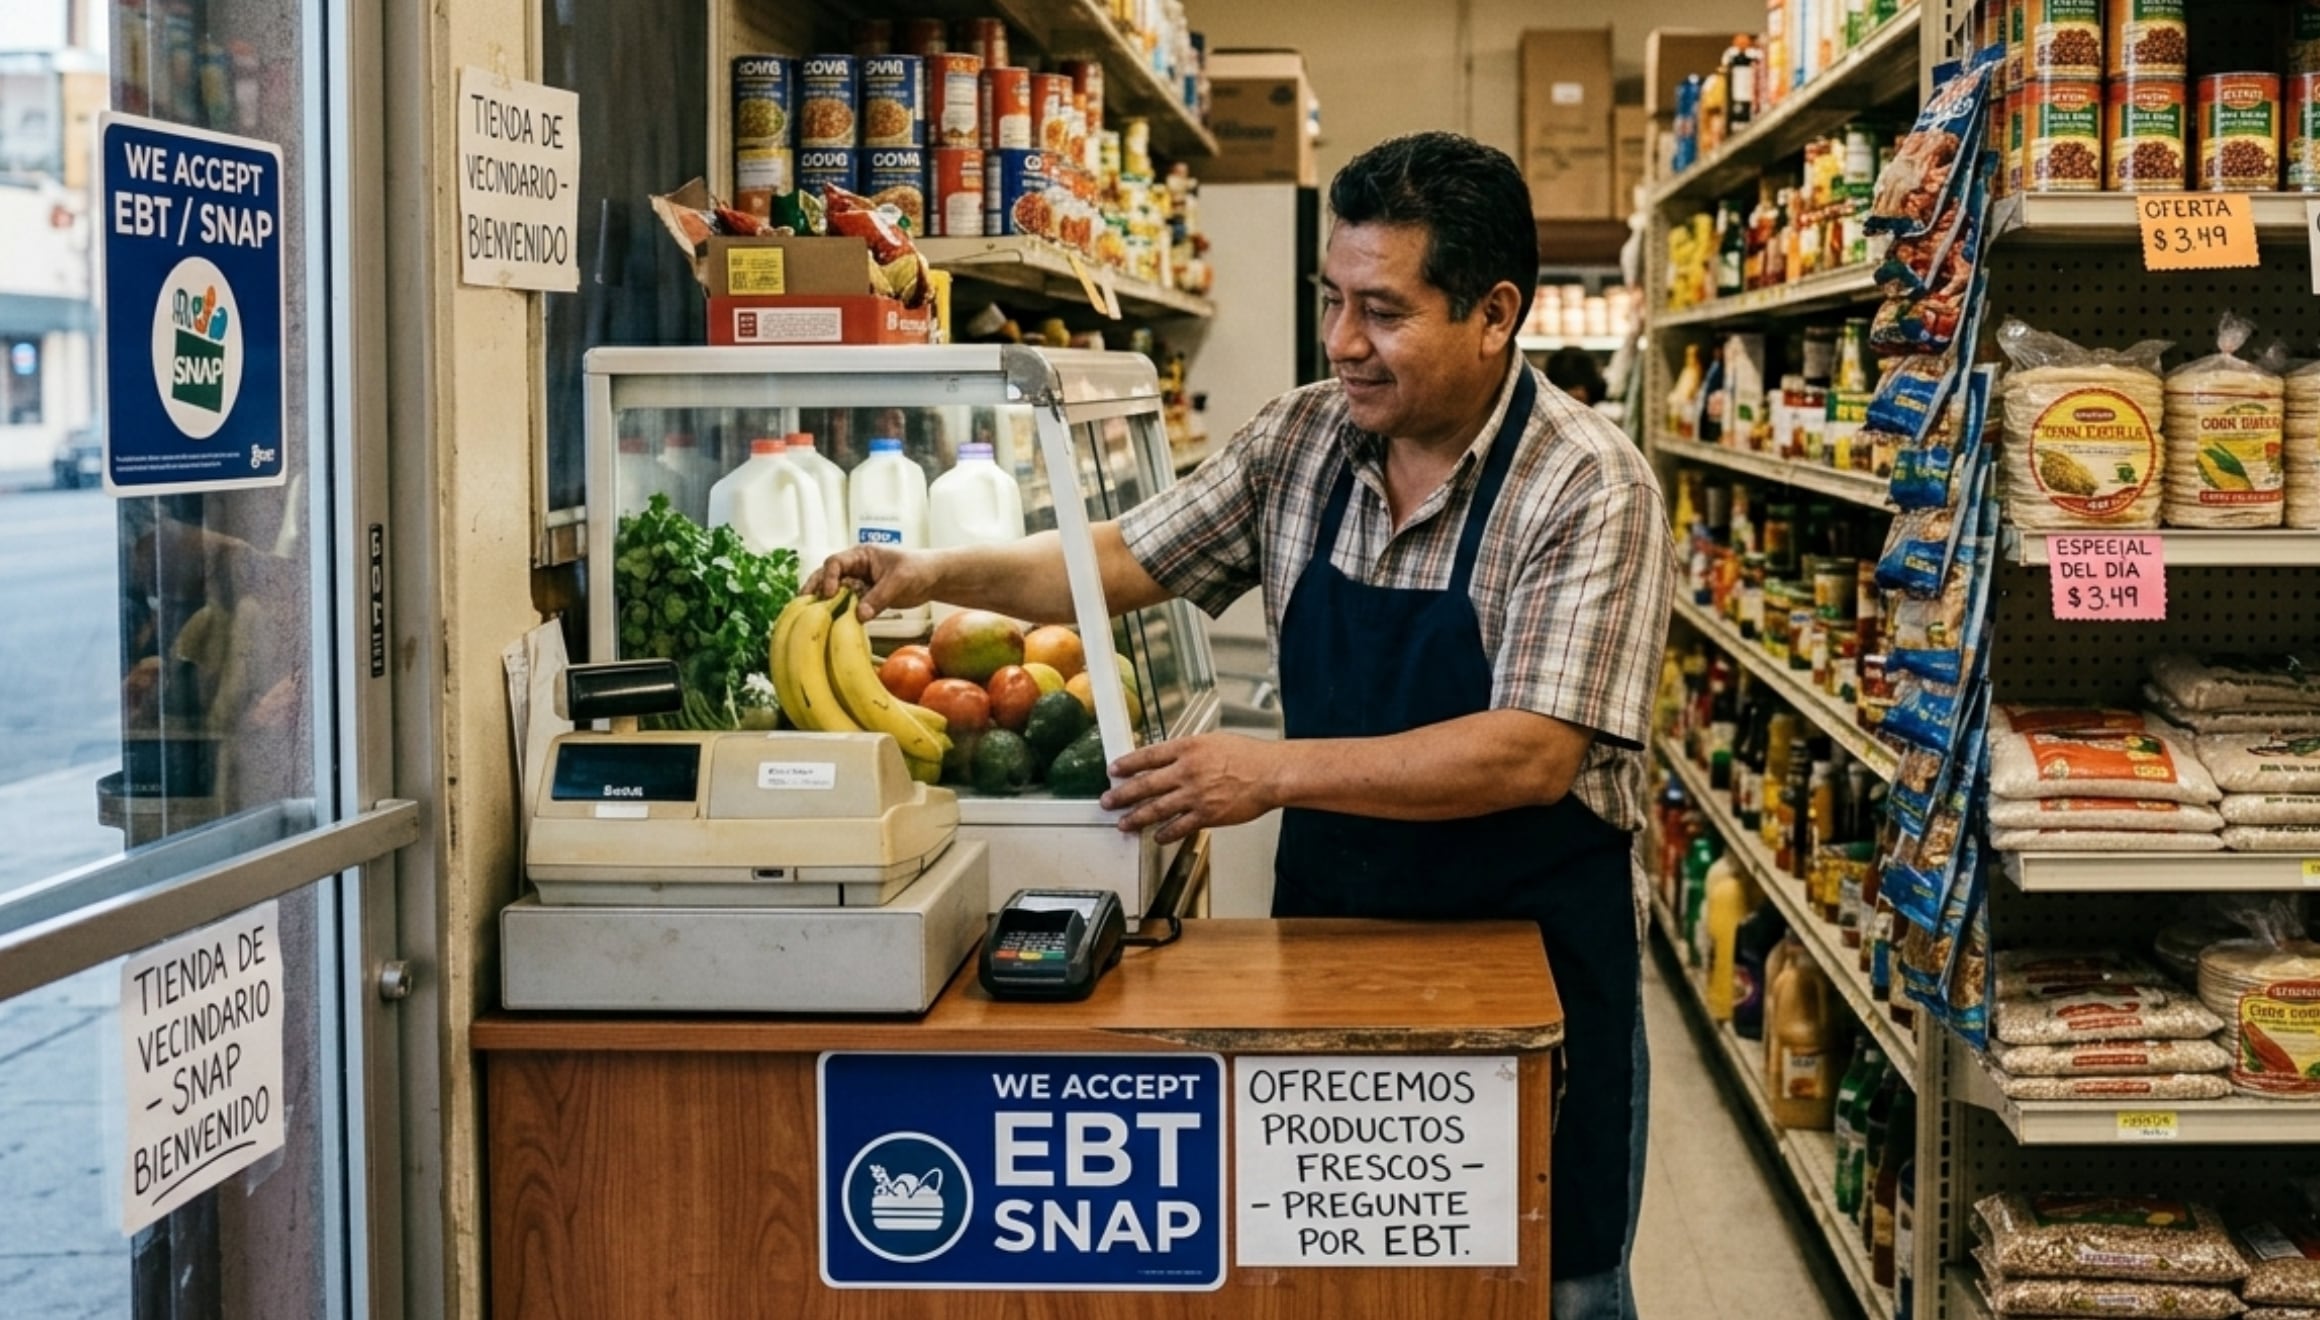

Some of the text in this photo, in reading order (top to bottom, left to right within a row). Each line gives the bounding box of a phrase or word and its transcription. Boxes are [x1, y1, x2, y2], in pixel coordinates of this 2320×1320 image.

[470, 94, 564, 149] TIENDA DE
[124, 142, 264, 196] WE ACCEPT
[466, 153, 558, 200] VECINDARIO
[115, 191, 172, 238] EBT
[200, 202, 273, 248] SNAP
[2145, 199, 2232, 218] OFERTA
[468, 214, 568, 265] BIENVENIDO
[174, 355, 224, 385] SNAP
[2060, 562, 2098, 579] DEL
[134, 925, 266, 1016] TIENDA DE
[137, 979, 270, 1073] VECINDARIO
[172, 1043, 242, 1115] SNAP
[993, 1073, 1200, 1100] WE ACCEPT
[1249, 1069, 1475, 1103] OFRECEMOS
[134, 1085, 269, 1196] BIENVENIDO
[994, 1111, 1201, 1188] EBT
[1261, 1113, 1465, 1145] PRODUCTOS
[1296, 1153, 1451, 1183] FRESCOS
[994, 1199, 1202, 1254] SNAP
[1282, 1191, 1469, 1219] PREGUNTE
[1298, 1224, 1471, 1257] POR EBT.
